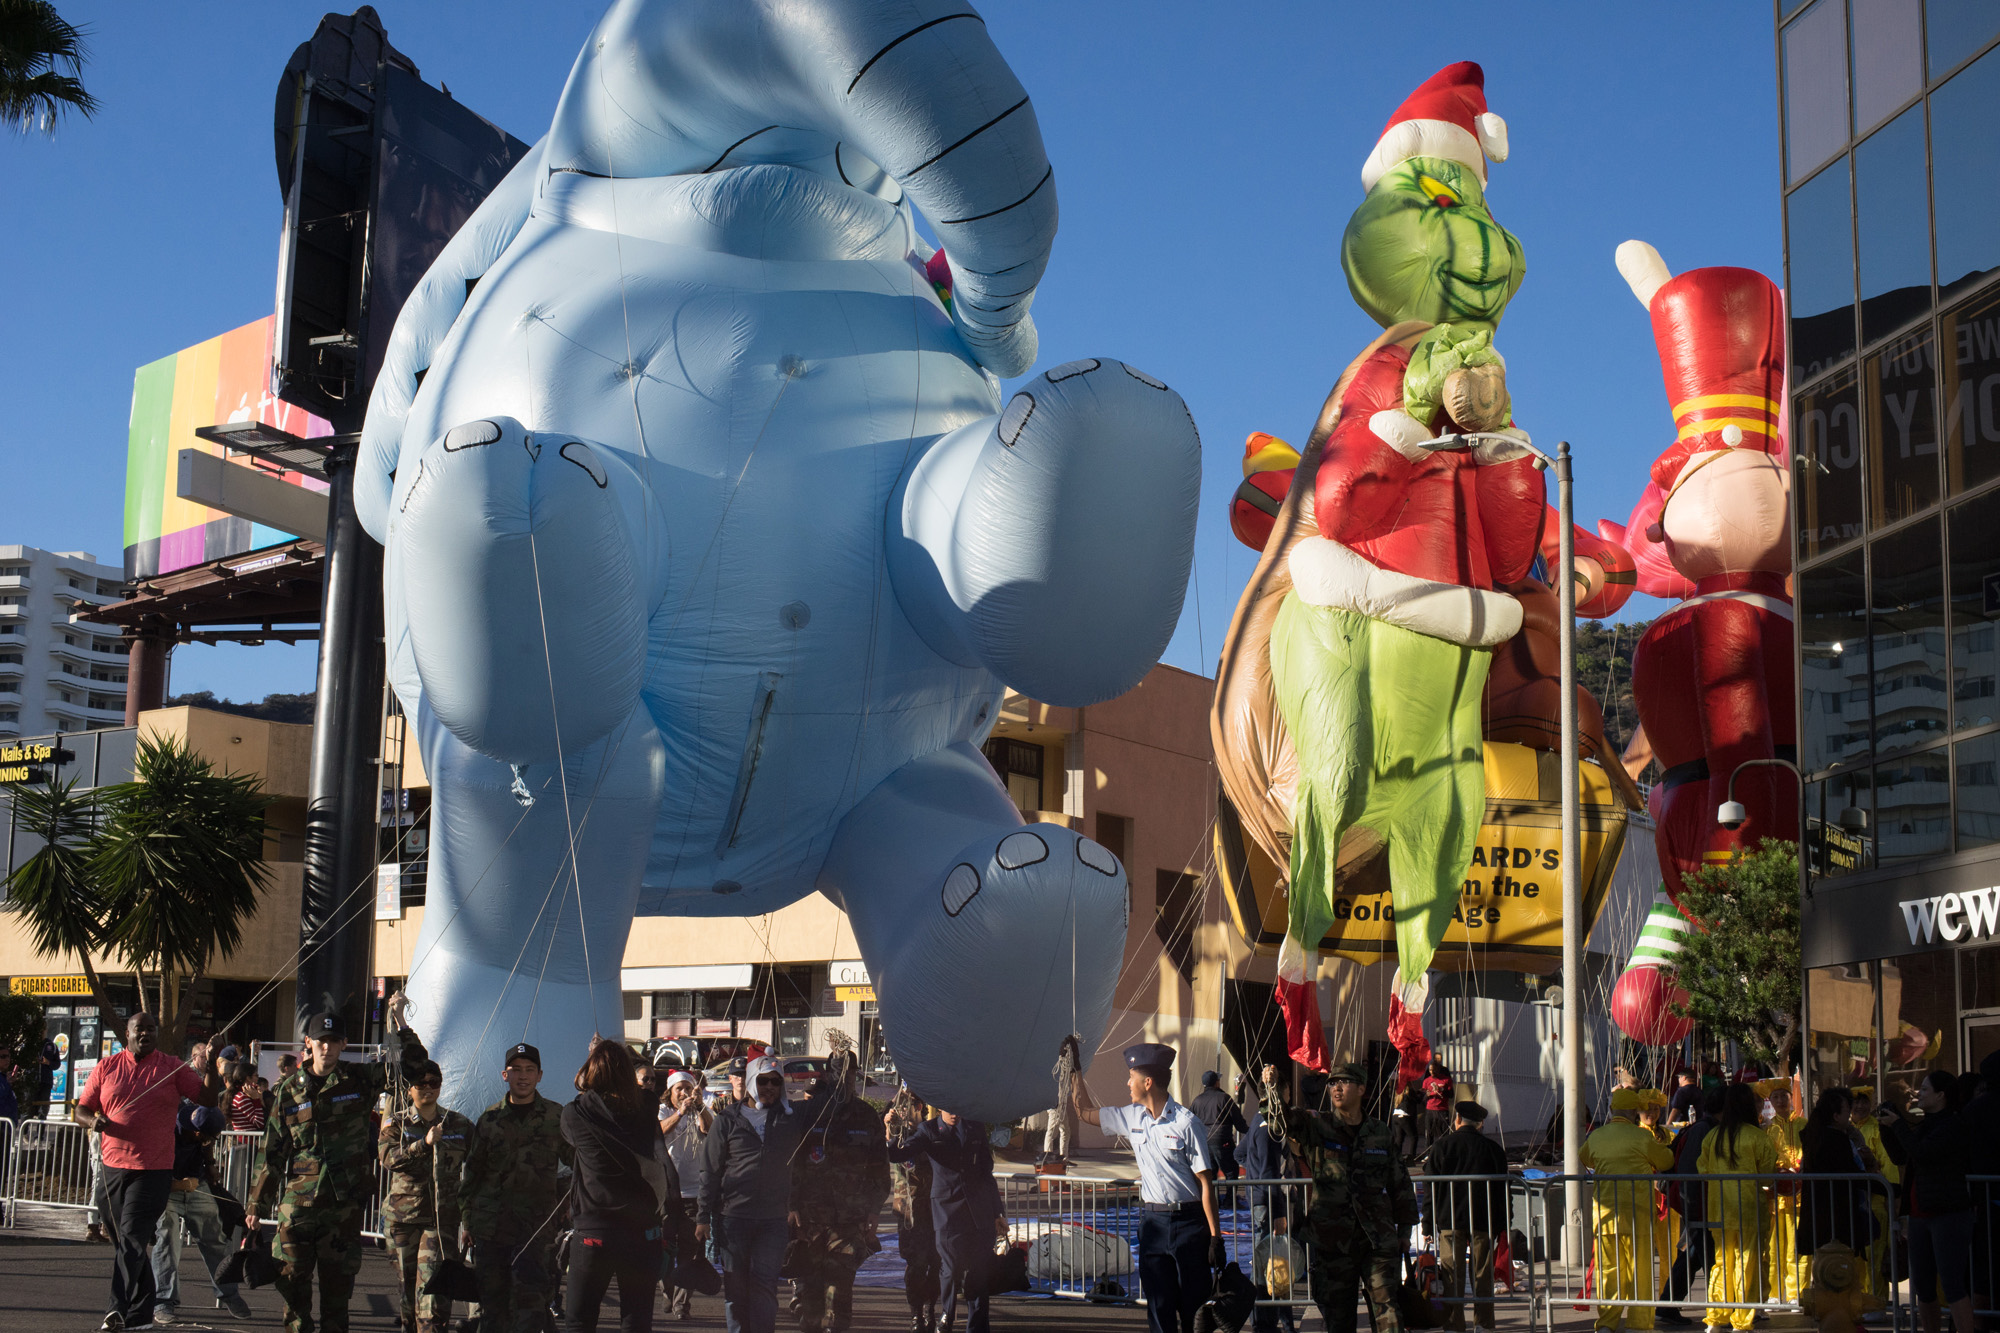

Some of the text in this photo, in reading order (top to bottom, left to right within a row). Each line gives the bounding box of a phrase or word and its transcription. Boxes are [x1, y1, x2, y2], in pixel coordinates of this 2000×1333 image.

[1, 743, 52, 763] Nails & Spa
[0, 766, 29, 782] NING
[1492, 875, 1540, 898] the
[1450, 904, 1501, 928] Age
[21, 978, 50, 993] CIGARS
